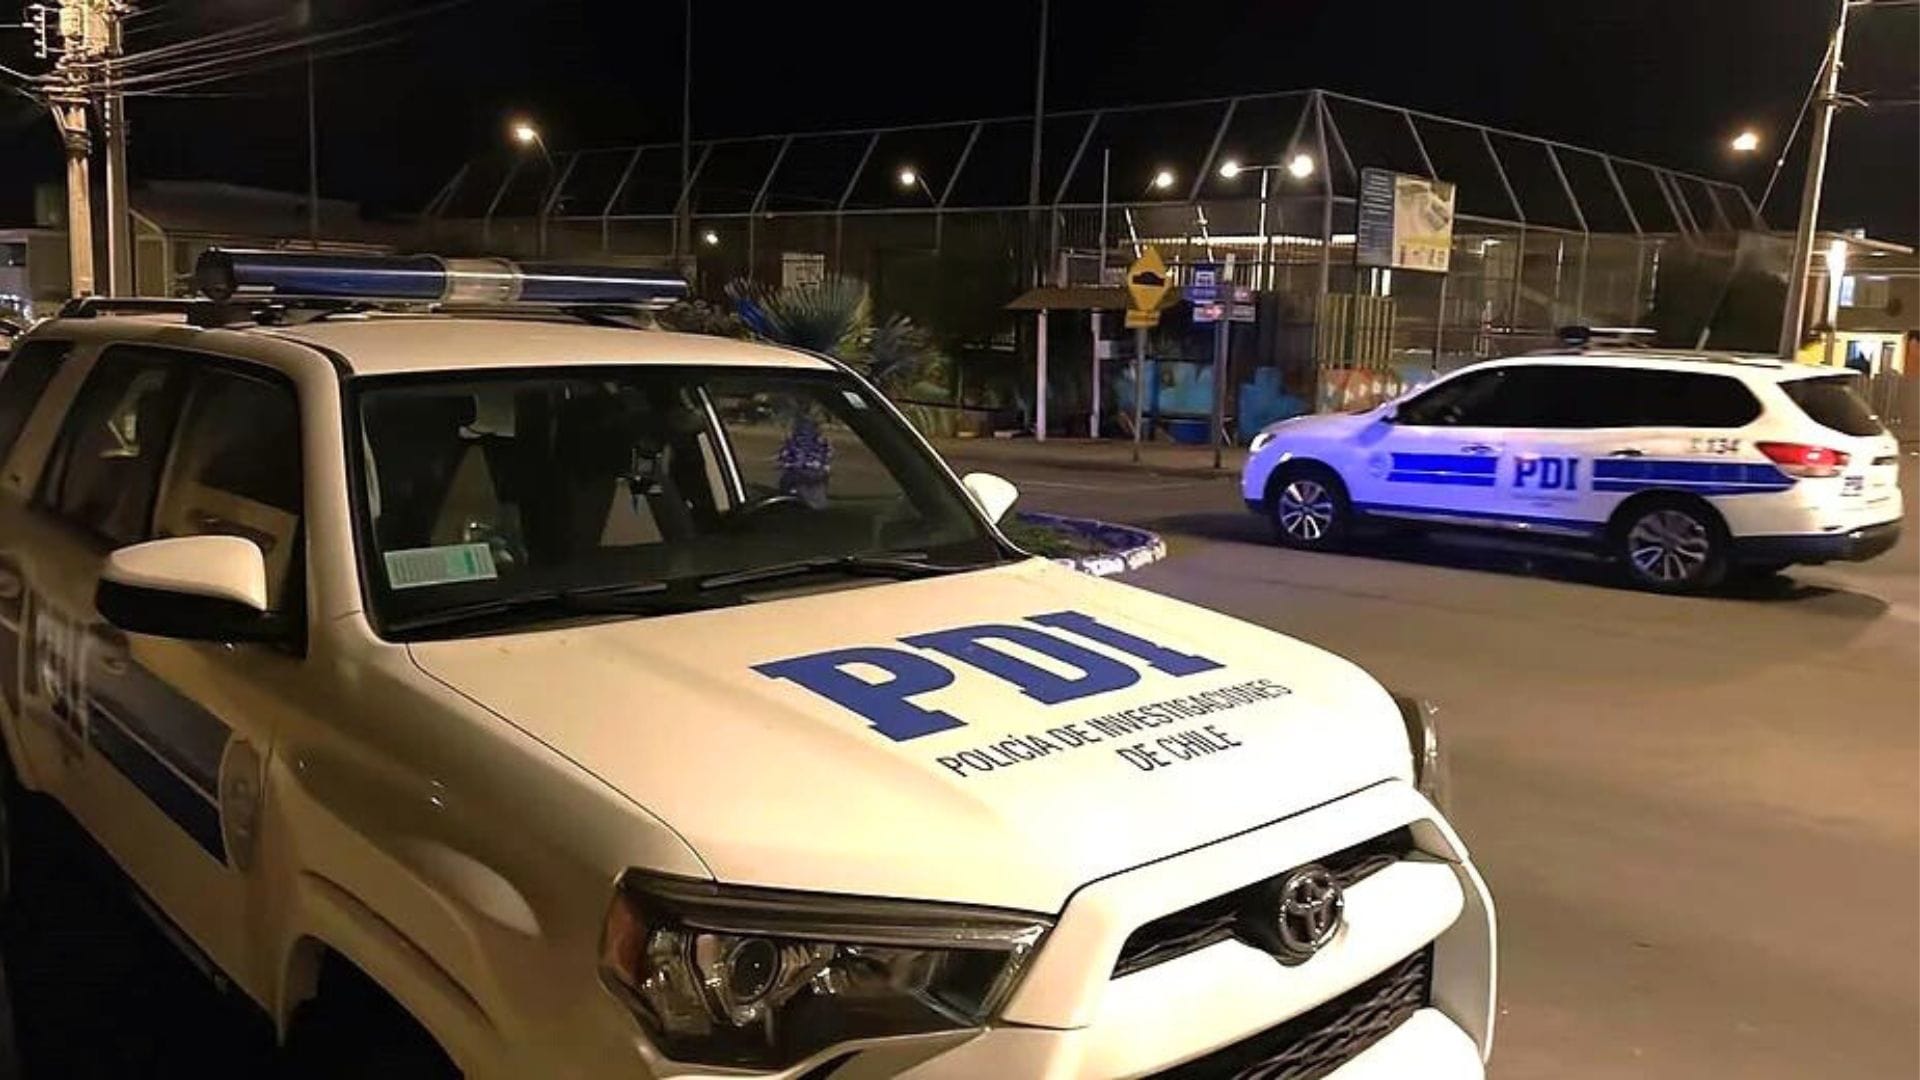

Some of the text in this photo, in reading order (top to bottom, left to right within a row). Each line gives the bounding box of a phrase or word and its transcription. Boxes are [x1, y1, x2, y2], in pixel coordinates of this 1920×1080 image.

[1513, 456, 1579, 490] PDI
[748, 610, 1227, 742] PDI
[935, 678, 1293, 778] POLICÍA DE INVESTIGACIONES
[1116, 724, 1242, 771] DE CHILE
